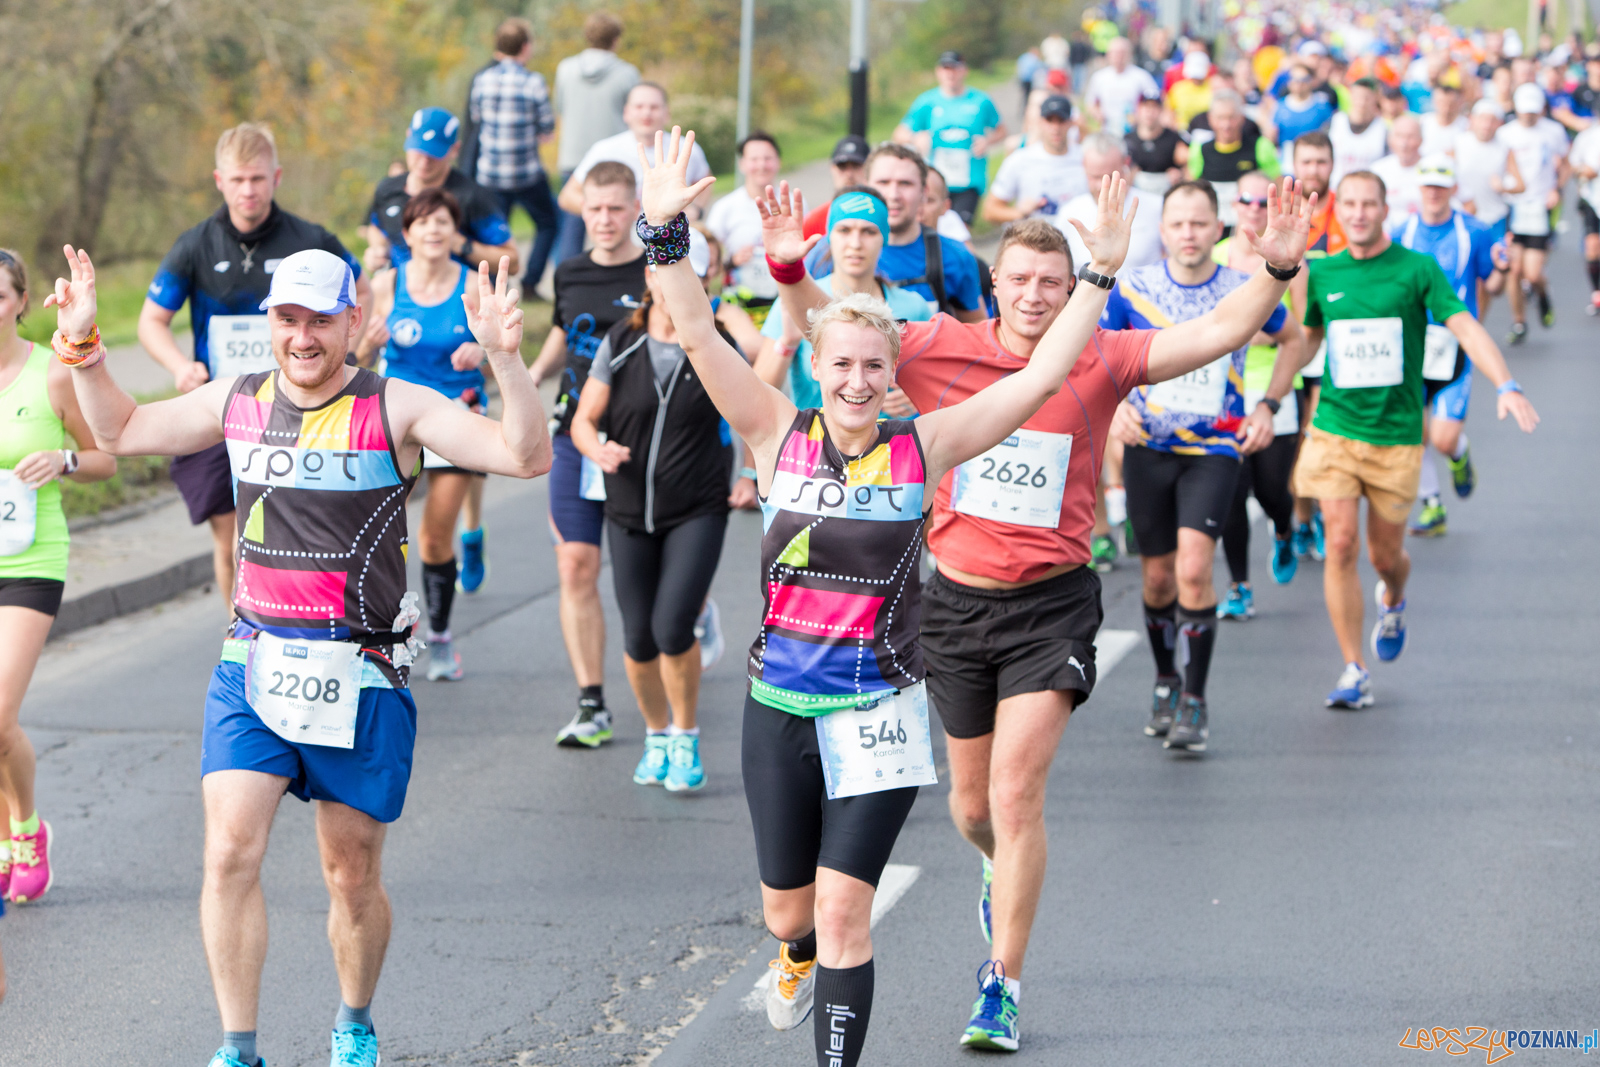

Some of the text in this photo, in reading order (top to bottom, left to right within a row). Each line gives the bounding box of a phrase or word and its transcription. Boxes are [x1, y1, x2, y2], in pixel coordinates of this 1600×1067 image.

[226, 340, 273, 358] 5207
[1344, 342, 1390, 359] 4834
[980, 456, 1047, 488] 2626
[292, 647, 306, 657] PKO
[268, 670, 341, 704] 2208
[288, 701, 315, 712] Marcin
[858, 718, 907, 749] 546
[873, 747, 905, 758] Karolina
